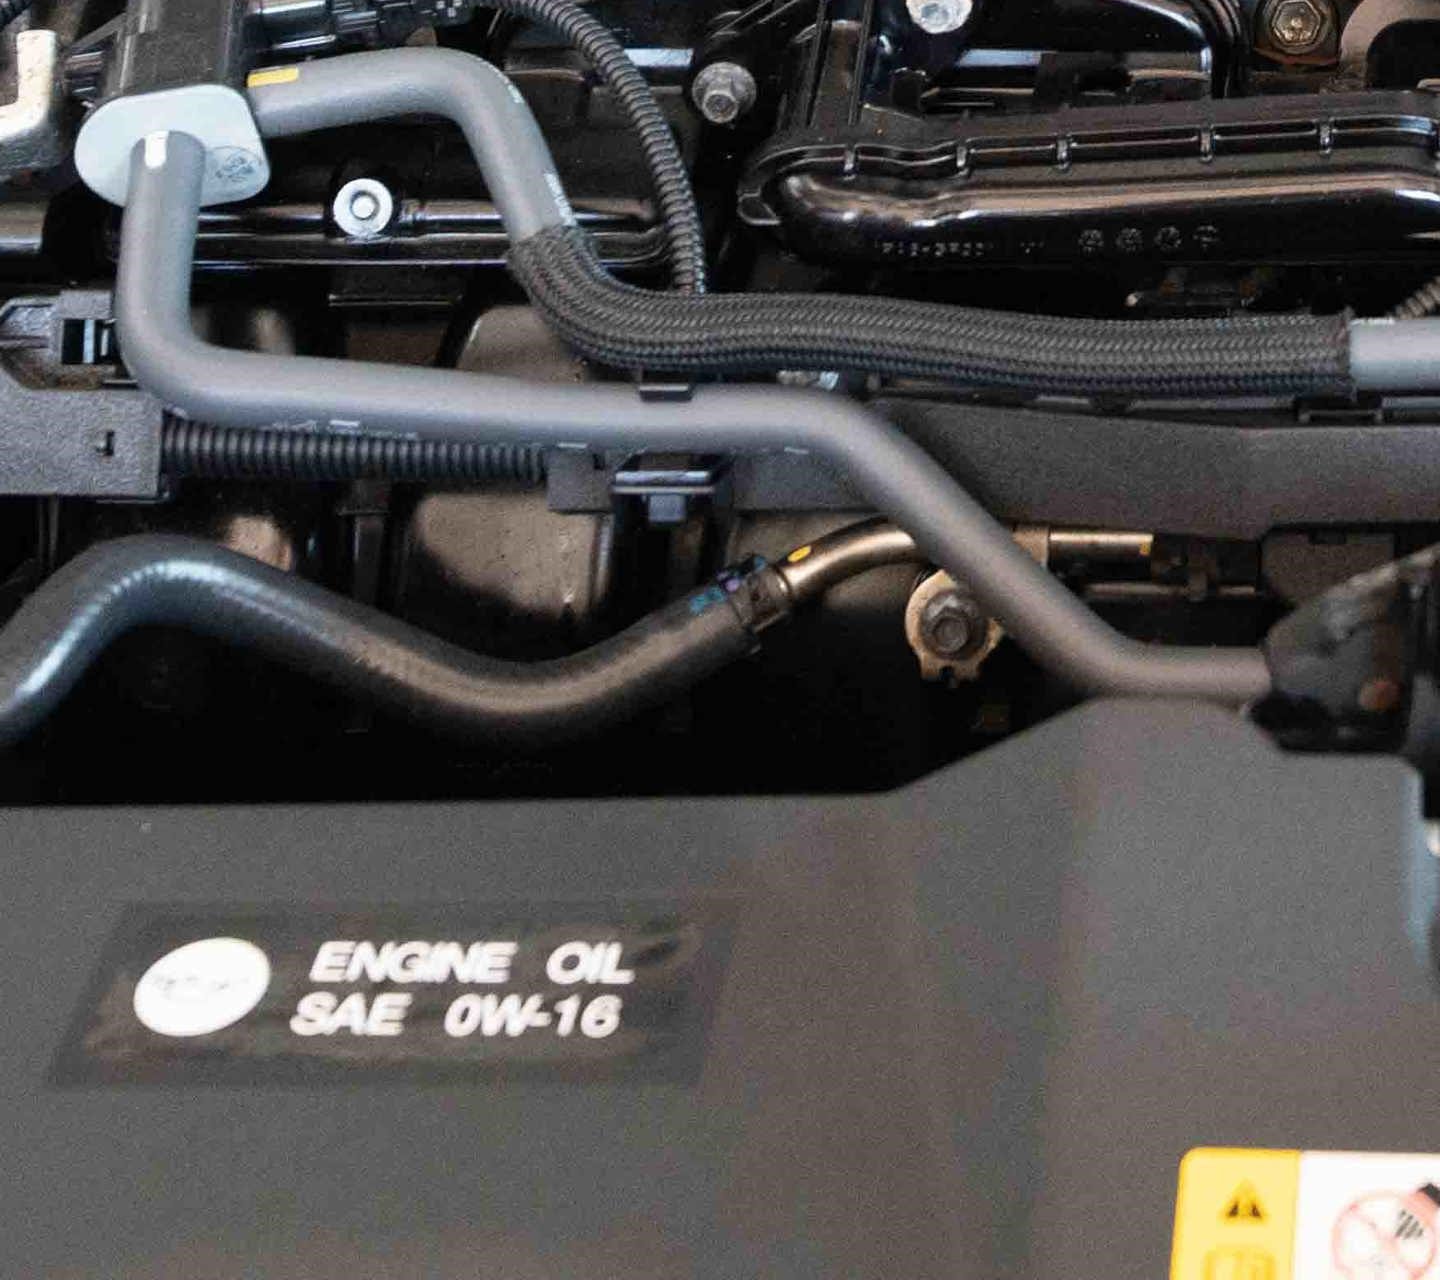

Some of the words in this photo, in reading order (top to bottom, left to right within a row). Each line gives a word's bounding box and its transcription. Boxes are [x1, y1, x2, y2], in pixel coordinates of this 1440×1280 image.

[308, 940, 517, 983] ENGINE
[545, 941, 635, 985] OIL
[288, 992, 412, 1037] SAE
[443, 994, 623, 1040] 0W-16
